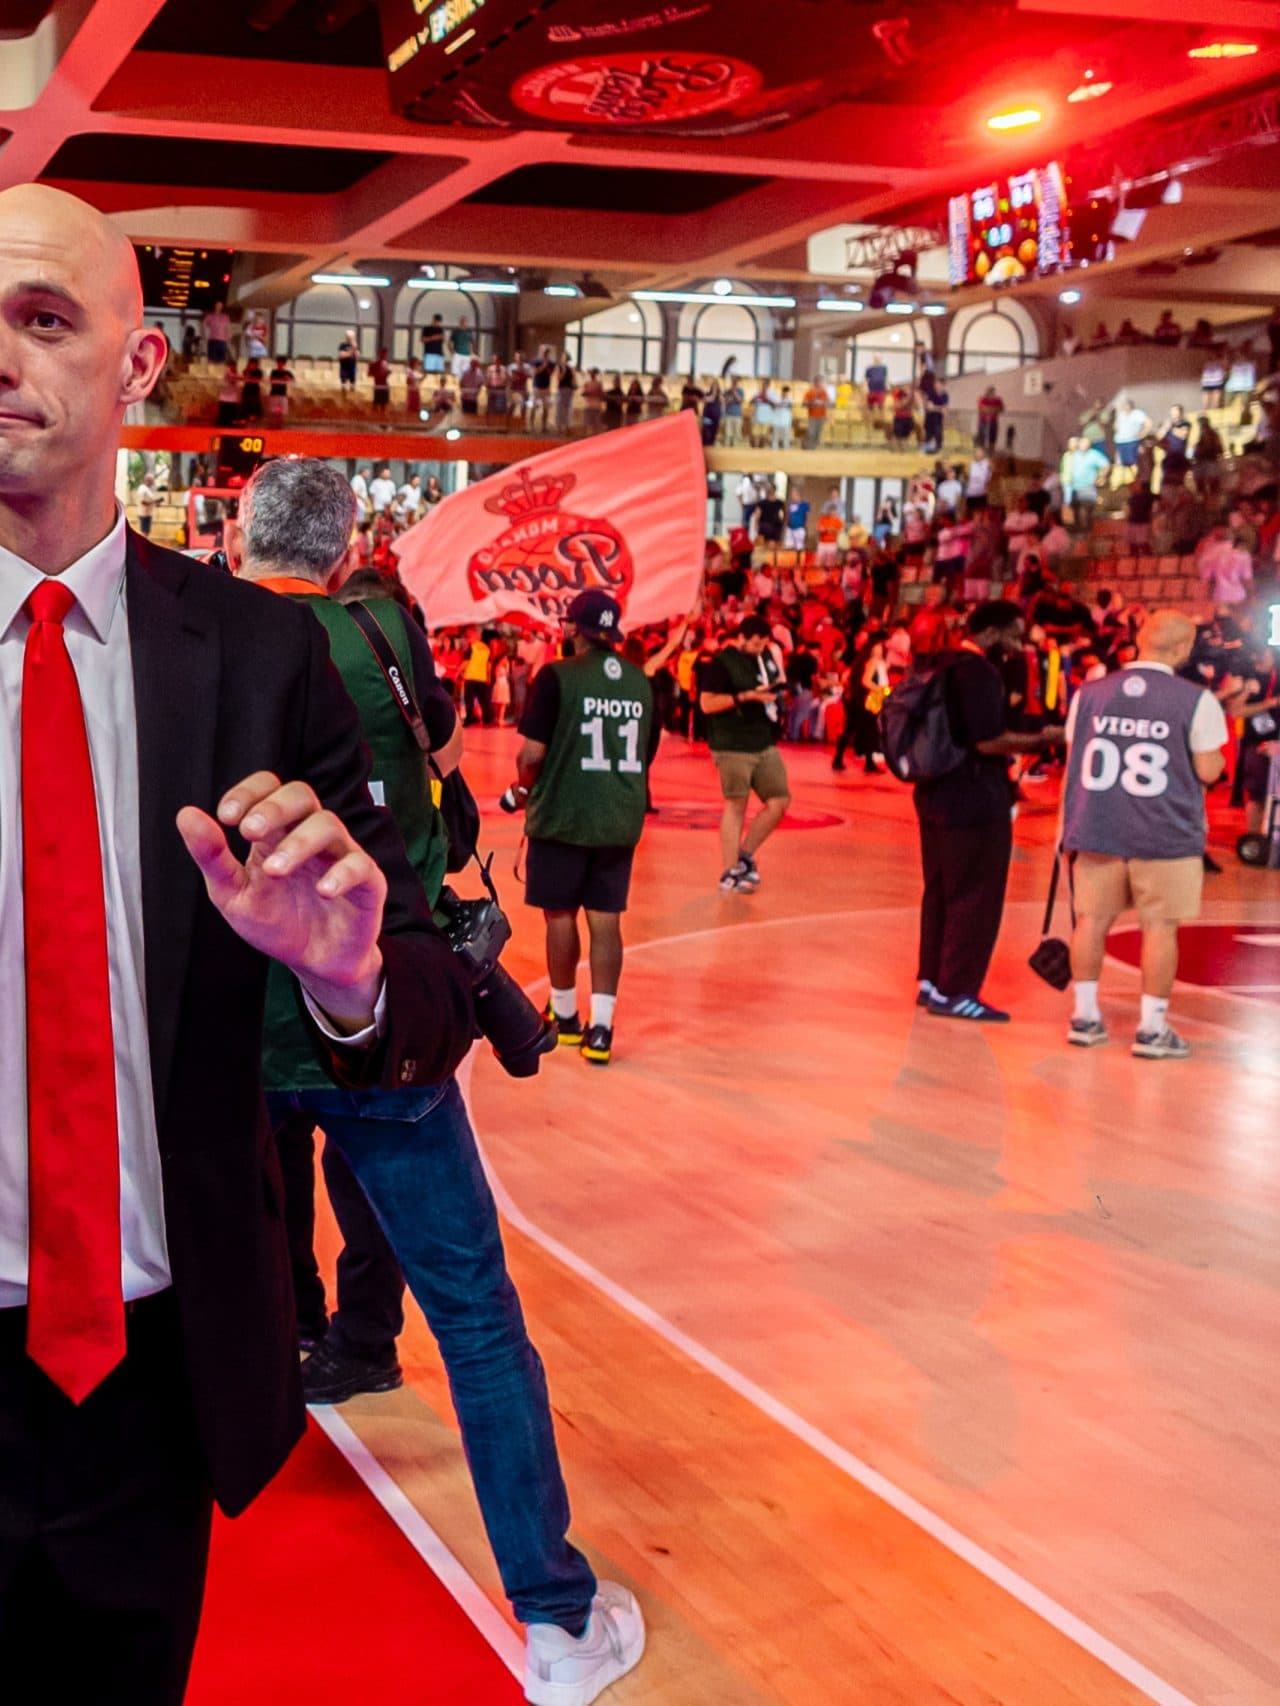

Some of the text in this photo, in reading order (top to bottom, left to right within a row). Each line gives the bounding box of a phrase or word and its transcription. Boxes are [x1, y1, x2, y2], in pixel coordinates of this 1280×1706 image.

[389, 666, 409, 705] Canon
[583, 697, 643, 718] PHOTO
[580, 717, 642, 773] 11
[1092, 715, 1170, 740] VIDEO
[1081, 737, 1169, 798] 08
